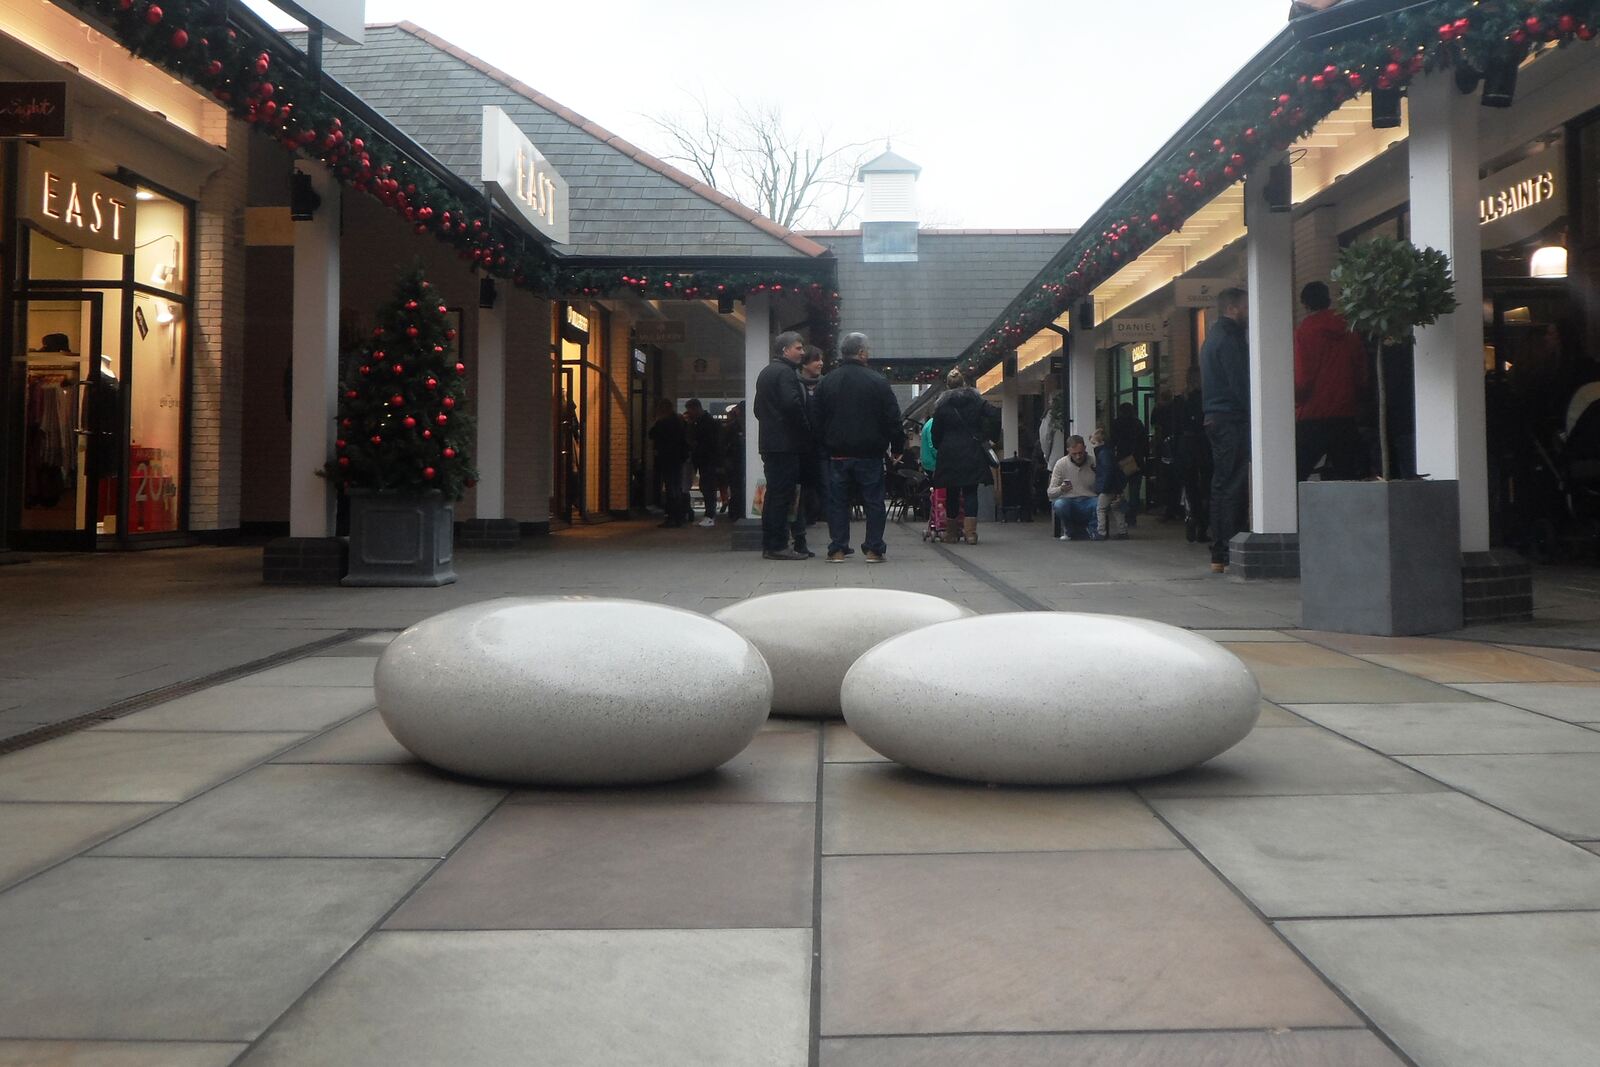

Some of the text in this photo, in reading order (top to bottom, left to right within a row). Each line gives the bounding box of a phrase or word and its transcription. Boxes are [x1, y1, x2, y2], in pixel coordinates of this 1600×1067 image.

[42, 171, 127, 241] EAST
[516, 147, 556, 225] EAST
[1479, 171, 1554, 226] LLSAINTS
[1117, 322, 1157, 332] DANIEL
